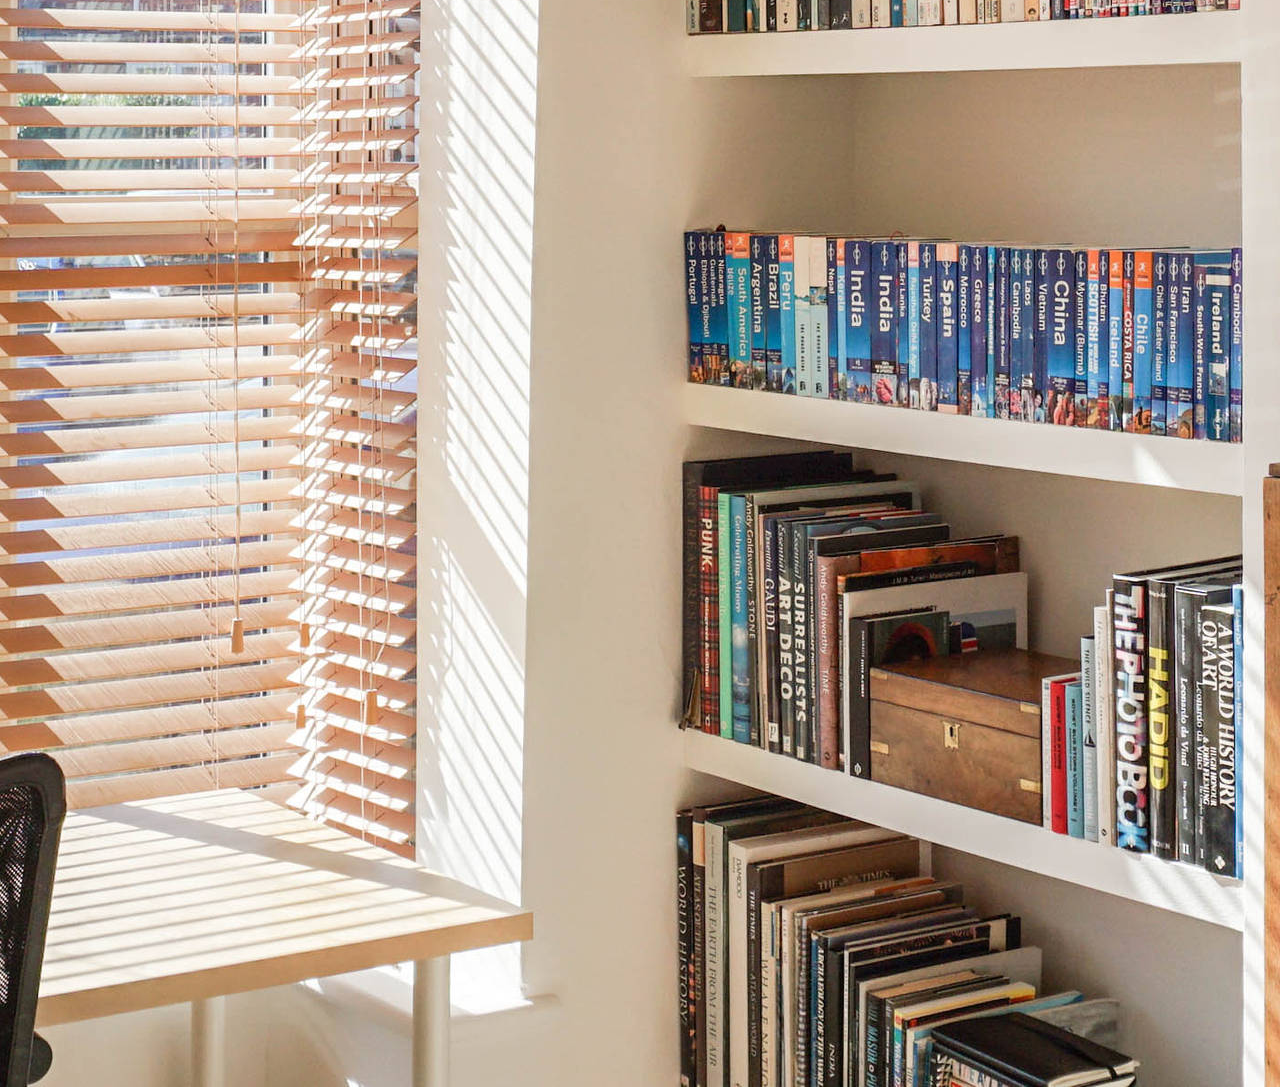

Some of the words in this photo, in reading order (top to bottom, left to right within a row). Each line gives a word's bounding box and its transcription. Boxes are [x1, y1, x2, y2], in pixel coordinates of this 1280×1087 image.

[688, 259, 697, 304] Portugal
[700, 259, 708, 293] Ethiopia
[738, 267, 747, 302] South
[751, 262, 762, 333] Argentina
[768, 263, 779, 308] Brazil
[782, 270, 792, 310] Peru
[1024, 281, 1032, 306] Laos
[1155, 285, 1164, 309] Chile
[1169, 286, 1178, 307] San
[702, 304, 710, 337] Djibouti
[850, 270, 865, 327] India
[879, 275, 894, 332] India
[921, 276, 932, 323] Turkey
[941, 280, 954, 337] Spain
[960, 276, 968, 328] Morocco
[974, 279, 983, 323] Greece
[1012, 282, 1021, 339] Cambodia
[1039, 283, 1047, 331] Vietnam
[1054, 280, 1069, 345] China
[1076, 281, 1085, 330] Myanmar
[1088, 283, 1098, 341] SCOTTISH
[1182, 286, 1192, 313] Iran
[1232, 283, 1241, 344] Cambodia
[739, 306, 747, 356] America
[1110, 316, 1120, 368] Iceland
[1124, 310, 1132, 349] COSTA
[1136, 314, 1148, 354] Chile
[1155, 321, 1164, 351] Easter
[1169, 311, 1178, 363] Francisco
[1196, 305, 1204, 365] South-West
[1212, 292, 1223, 354] Ireland
[1076, 332, 1085, 376] (Burma)
[1124, 352, 1132, 379] RICA
[1155, 353, 1164, 381] Island
[1196, 368, 1204, 400] France
[746, 501, 754, 527] Andy
[701, 517, 713, 571] PUNK.
[733, 514, 742, 577] Celebrating
[746, 529, 754, 592] Goldsworthy
[765, 529, 774, 571] Essential
[777, 524, 787, 573] Essential
[793, 529, 802, 579] Essential
[733, 579, 742, 614] Moore
[820, 564, 829, 590] Andy
[764, 578, 775, 630] GAUDI
[777, 575, 792, 624] ART
[820, 592, 829, 654] Goldsworthy
[1202, 620, 1218, 644] OF
[1218, 622, 1235, 638] A
[777, 632, 792, 699] DECO
[794, 581, 807, 722] SURREALISTS
[1202, 644, 1218, 690] ART
[821, 668, 830, 694] TIME
[1180, 677, 1189, 724] Leonardo
[1218, 642, 1235, 718] WORLD
[1149, 646, 1169, 791] HADID
[1195, 680, 1205, 727] Leonardo
[1180, 727, 1189, 738] da
[1180, 741, 1189, 767] Vinci
[1195, 730, 1205, 742] da
[1195, 744, 1205, 770] Vinci
[1202, 745, 1210, 765] JOHN
[1210, 746, 1218, 764] HUGH
[1218, 723, 1235, 811] HISTORY
[1202, 767, 1210, 806] FLEMING
[1210, 768, 1218, 806] HONOUR
[677, 865, 687, 932] WORLD
[708, 884, 718, 914] THE
[749, 888, 757, 909] THE
[708, 917, 718, 963] EARTH
[749, 910, 757, 939] TIMES
[678, 941, 688, 1018] HISTORY
[708, 967, 718, 1007] FROM
[817, 946, 825, 1021] ARCHAEOLOGY
[708, 1012, 718, 1040] THE
[817, 1023, 825, 1034] OF
[817, 1038, 825, 1056] THE
[868, 1025, 879, 1064] MASON
[708, 1044, 718, 1066] AIR
